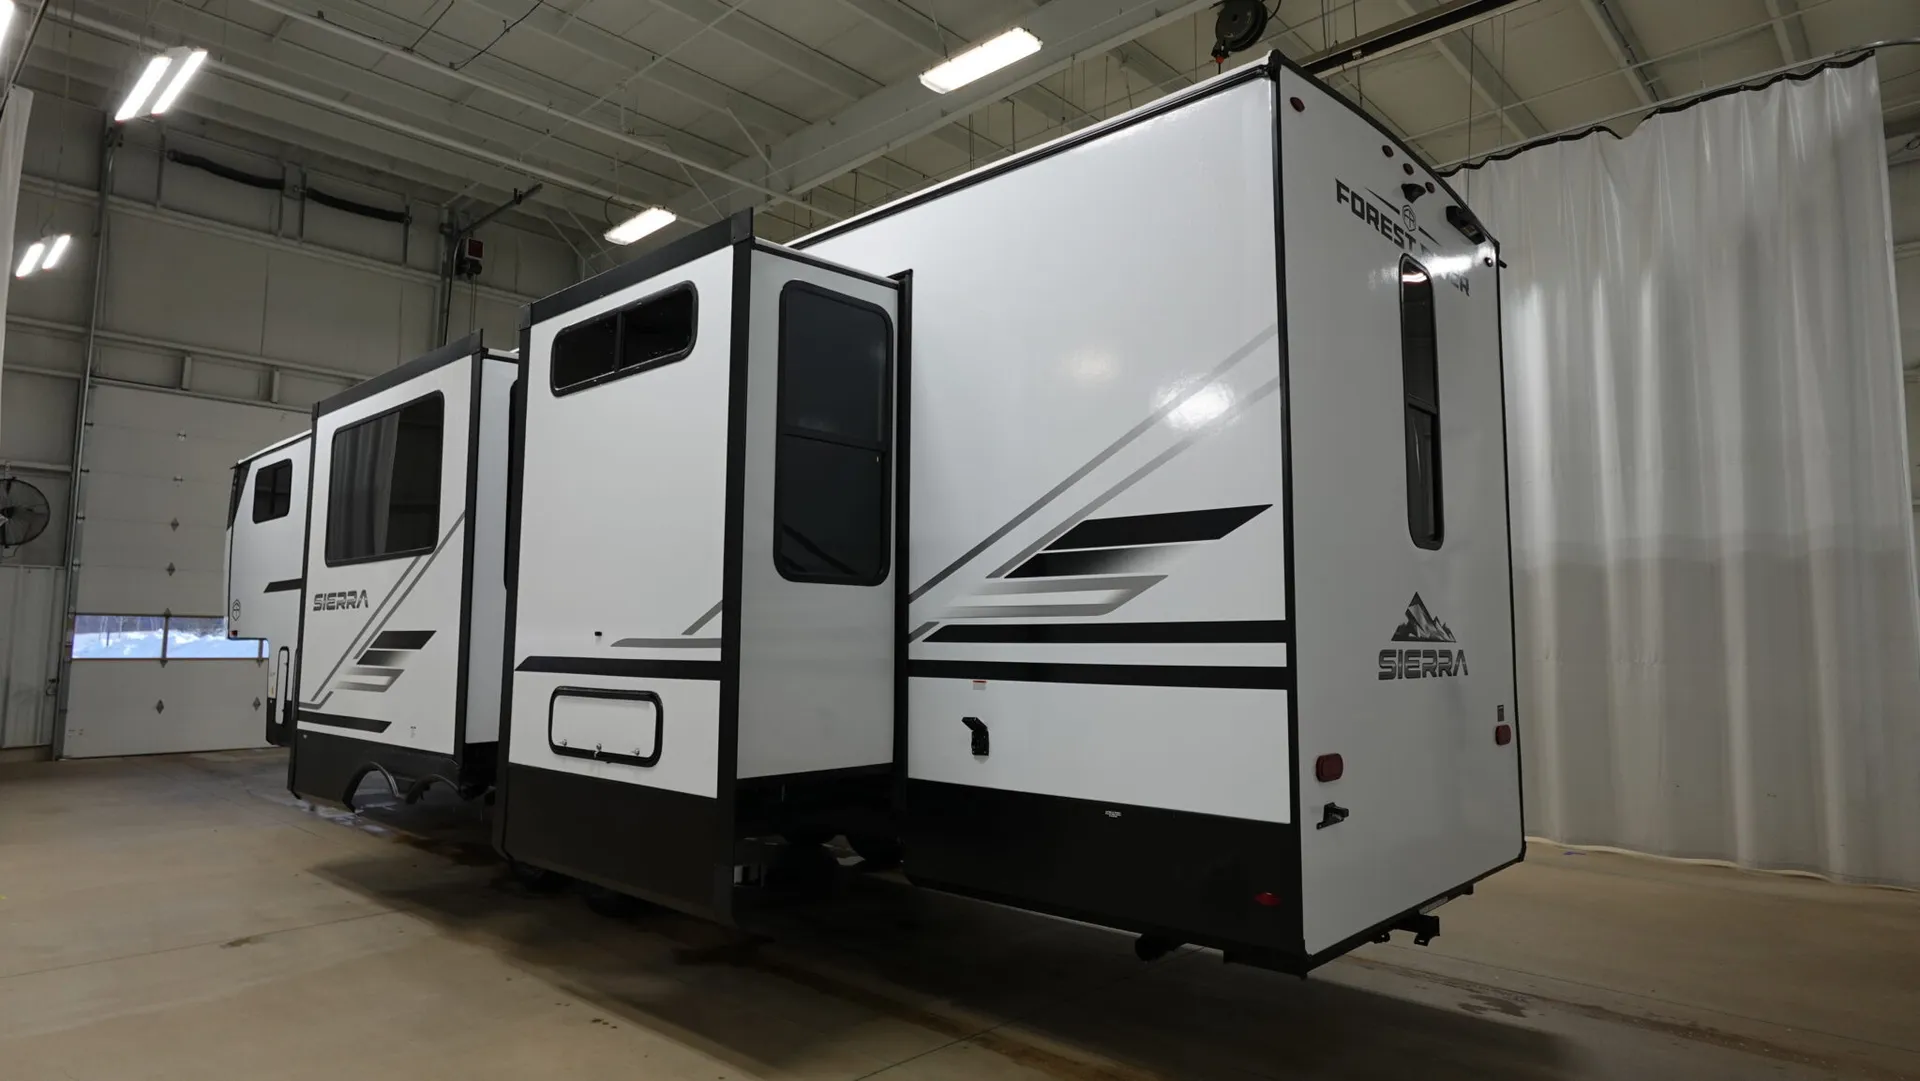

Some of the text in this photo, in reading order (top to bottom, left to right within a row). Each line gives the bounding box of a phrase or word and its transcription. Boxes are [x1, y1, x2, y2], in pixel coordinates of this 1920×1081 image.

[1335, 178, 1417, 251] FOREST
[312, 589, 369, 612] SIERRA
[1378, 649, 1469, 681] SIERRA
